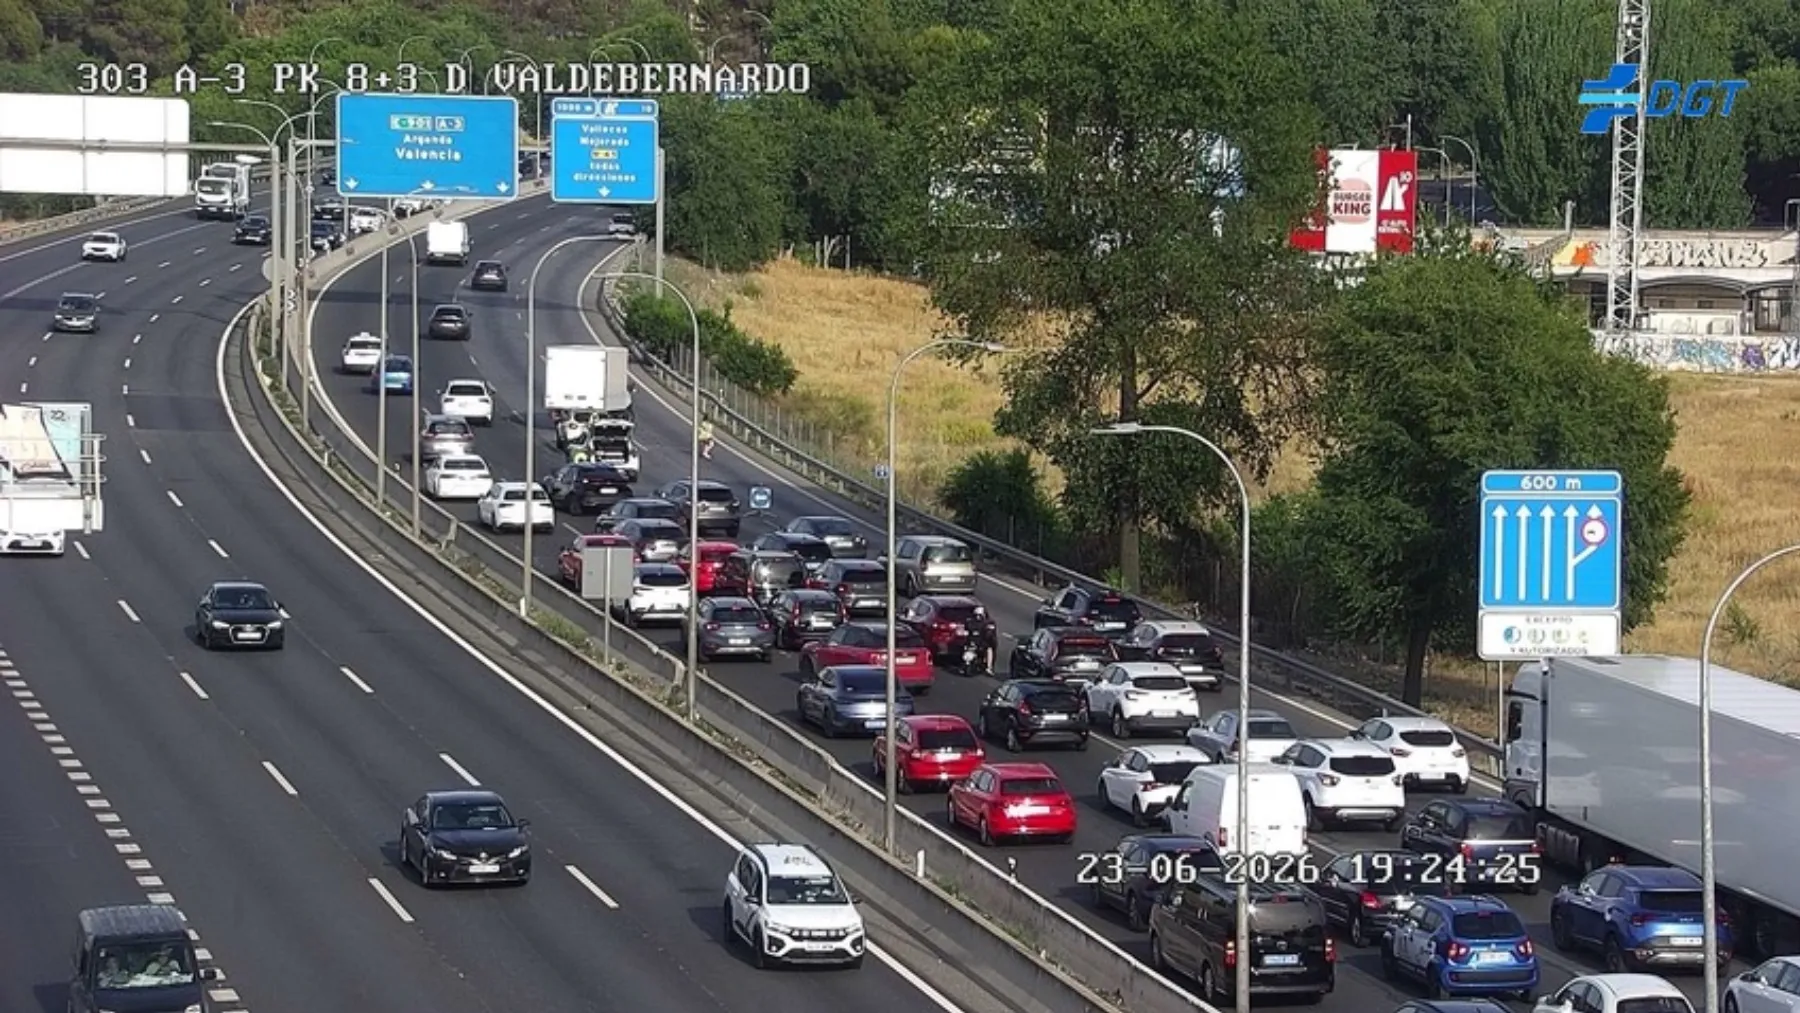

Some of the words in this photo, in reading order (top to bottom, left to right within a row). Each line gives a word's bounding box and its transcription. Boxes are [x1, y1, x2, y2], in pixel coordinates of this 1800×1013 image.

[581, 124, 628, 133] Vallecas
[395, 148, 462, 161] Valencia
[1333, 192, 1372, 201] BURGER
[1333, 203, 1371, 215] KING
[1520, 476, 1557, 490] 600
[1565, 477, 1581, 490] m
